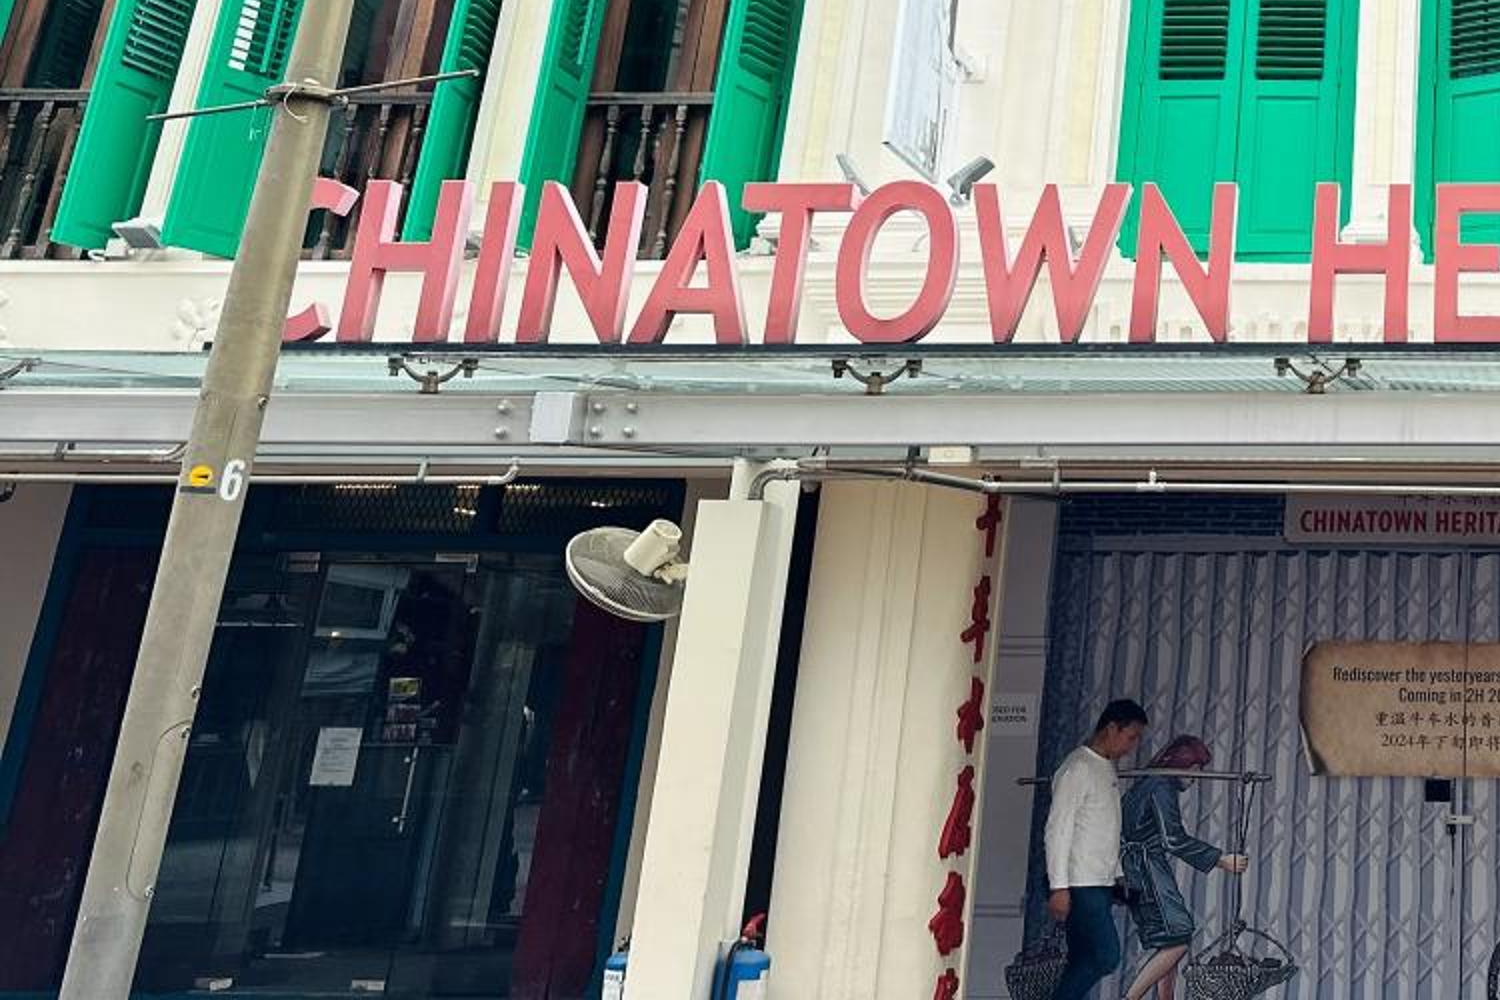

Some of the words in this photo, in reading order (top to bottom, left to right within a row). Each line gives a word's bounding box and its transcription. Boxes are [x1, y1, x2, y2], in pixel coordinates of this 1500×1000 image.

[220, 459, 246, 501] 6
[1300, 510, 1427, 533] CHINATOWN
[1333, 667, 1401, 682] Rediscover
[1405, 667, 1425, 682] the
[1399, 687, 1446, 704] Coming
[1449, 688, 1461, 702] in
[1465, 687, 1484, 703] 2H
